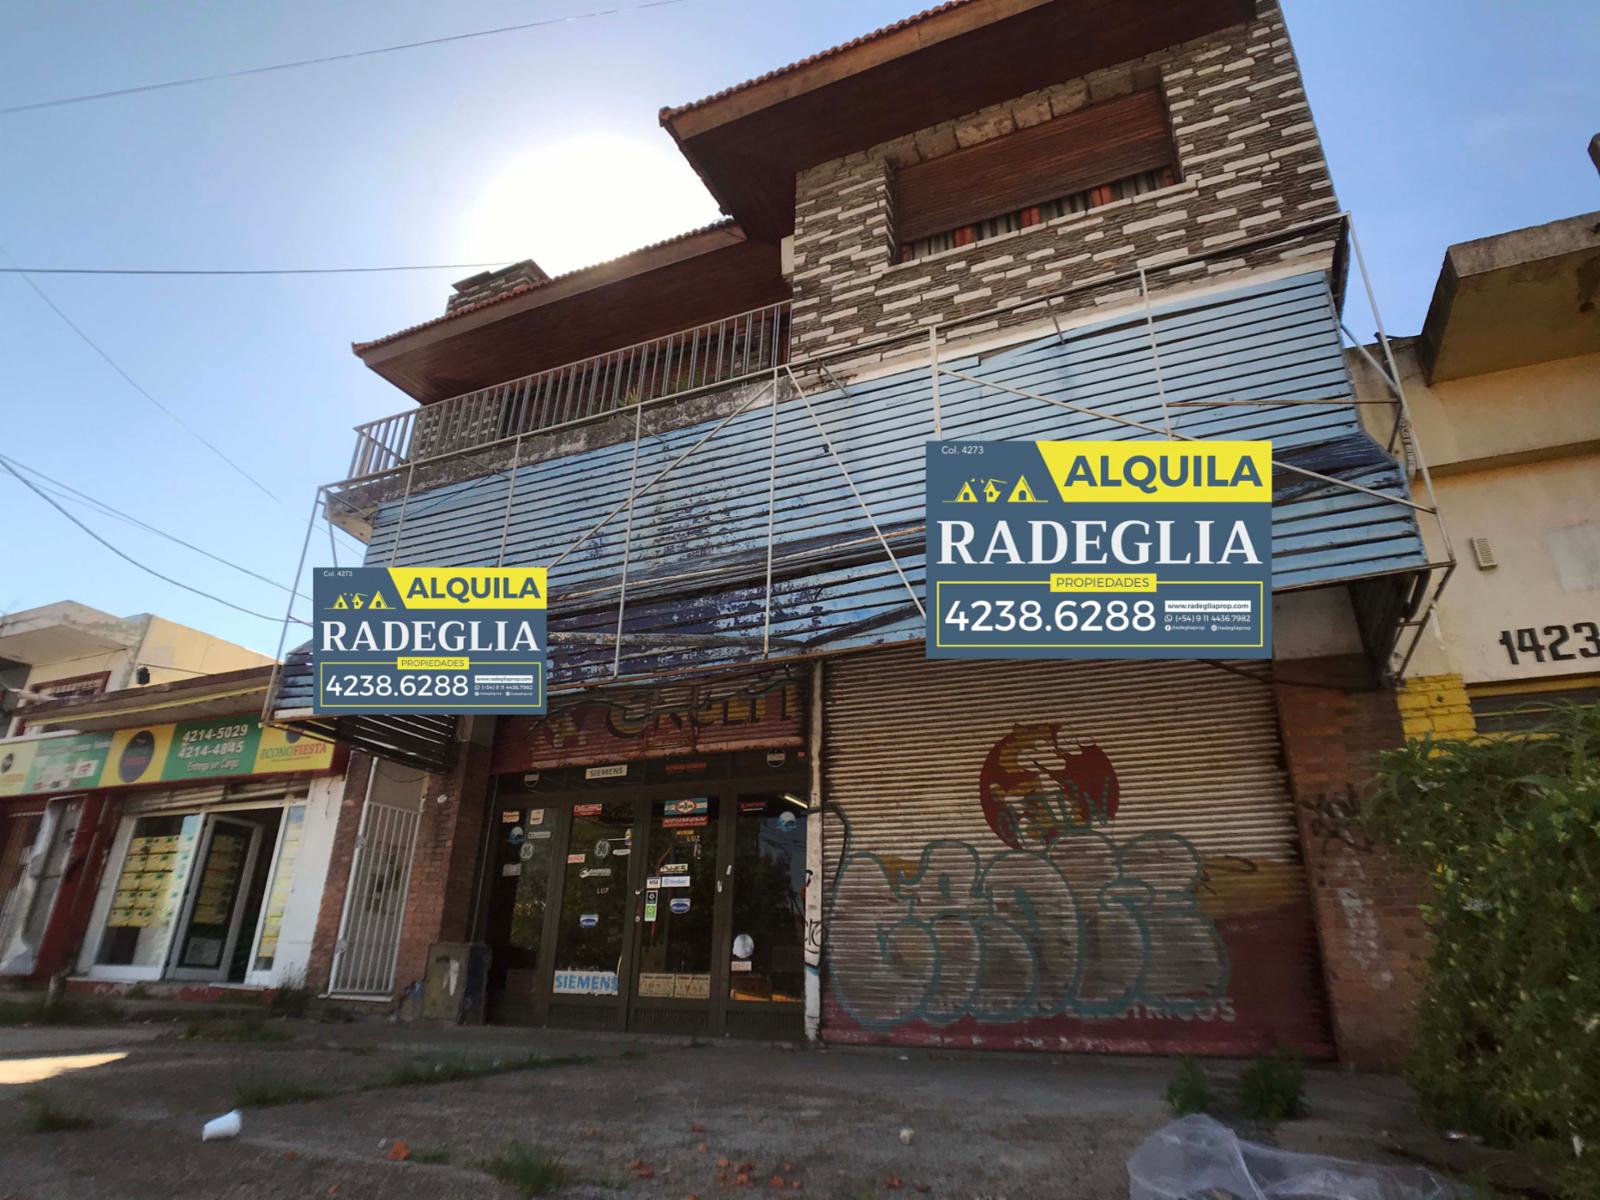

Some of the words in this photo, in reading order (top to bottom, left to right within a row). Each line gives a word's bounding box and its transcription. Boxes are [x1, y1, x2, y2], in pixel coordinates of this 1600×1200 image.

[1499, 622, 1600, 665] 1423
[183, 724, 249, 743] 4214-5029
[590, 766, 624, 778] SIEMENS
[555, 974, 619, 992] SIEMENS
